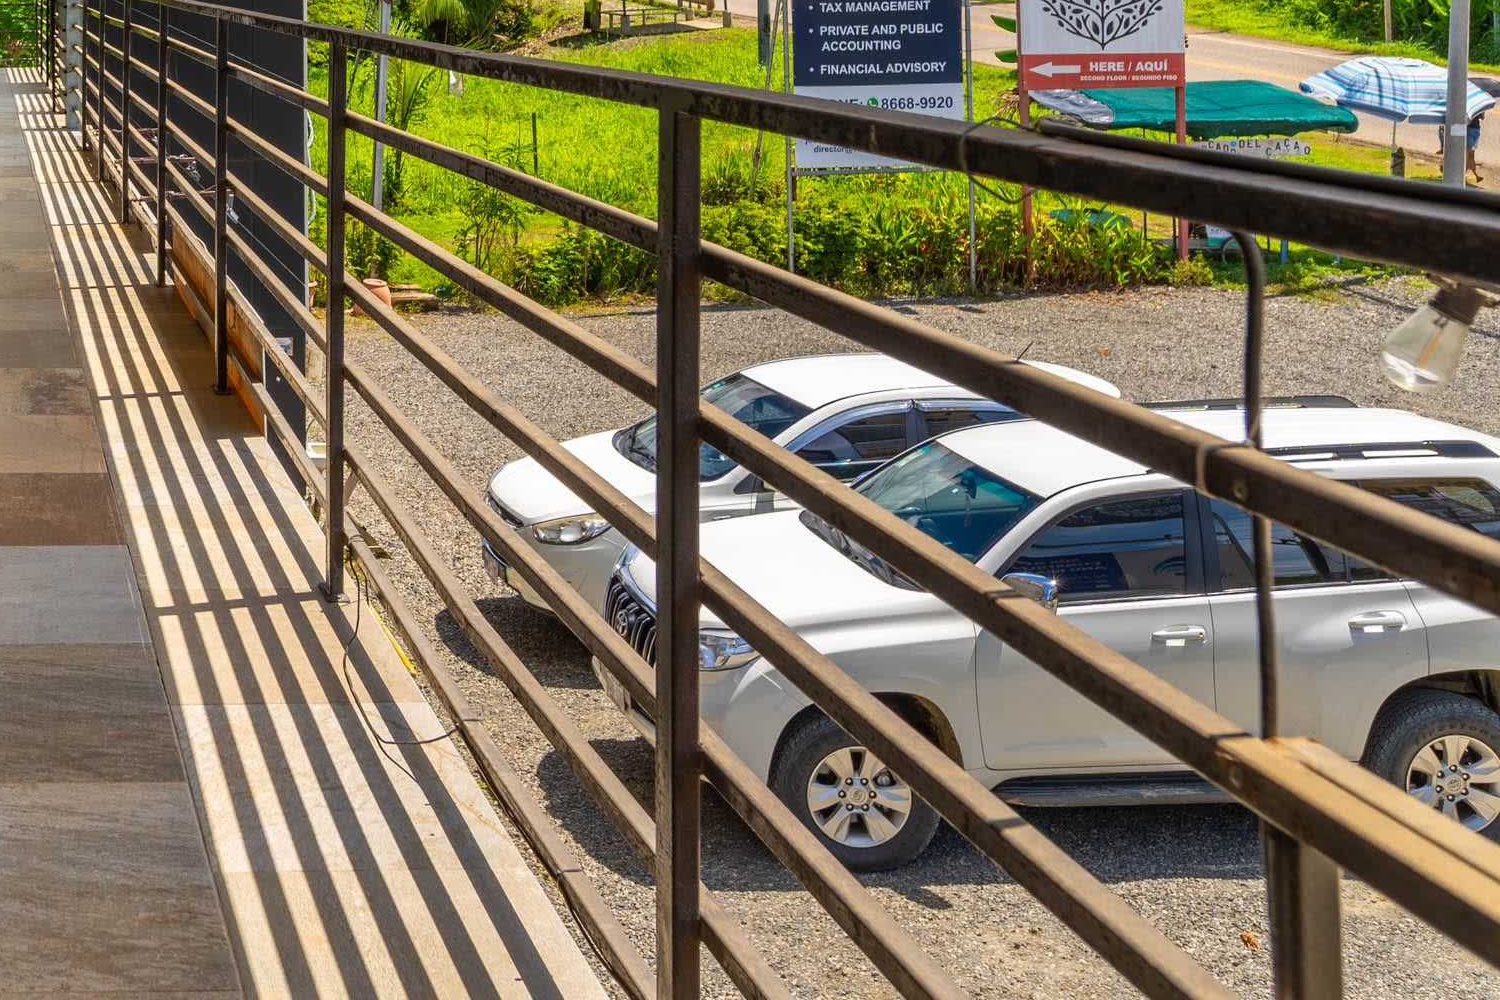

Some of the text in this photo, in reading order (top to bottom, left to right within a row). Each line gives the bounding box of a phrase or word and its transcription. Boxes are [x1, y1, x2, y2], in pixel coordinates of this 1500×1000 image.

[820, 0, 931, 13] TAX MANAGEMENT
[820, 23, 943, 36] PRIVATE AND PUBLIC
[822, 40, 901, 52] ACCOUNTING
[820, 62, 947, 75] FINANCIAL ADVISORY
[1089, 62, 1125, 72] HERE
[1135, 60, 1168, 72] AQUÍ
[881, 96, 953, 109] 8668-9920
[1239, 138, 1261, 148] DEL
